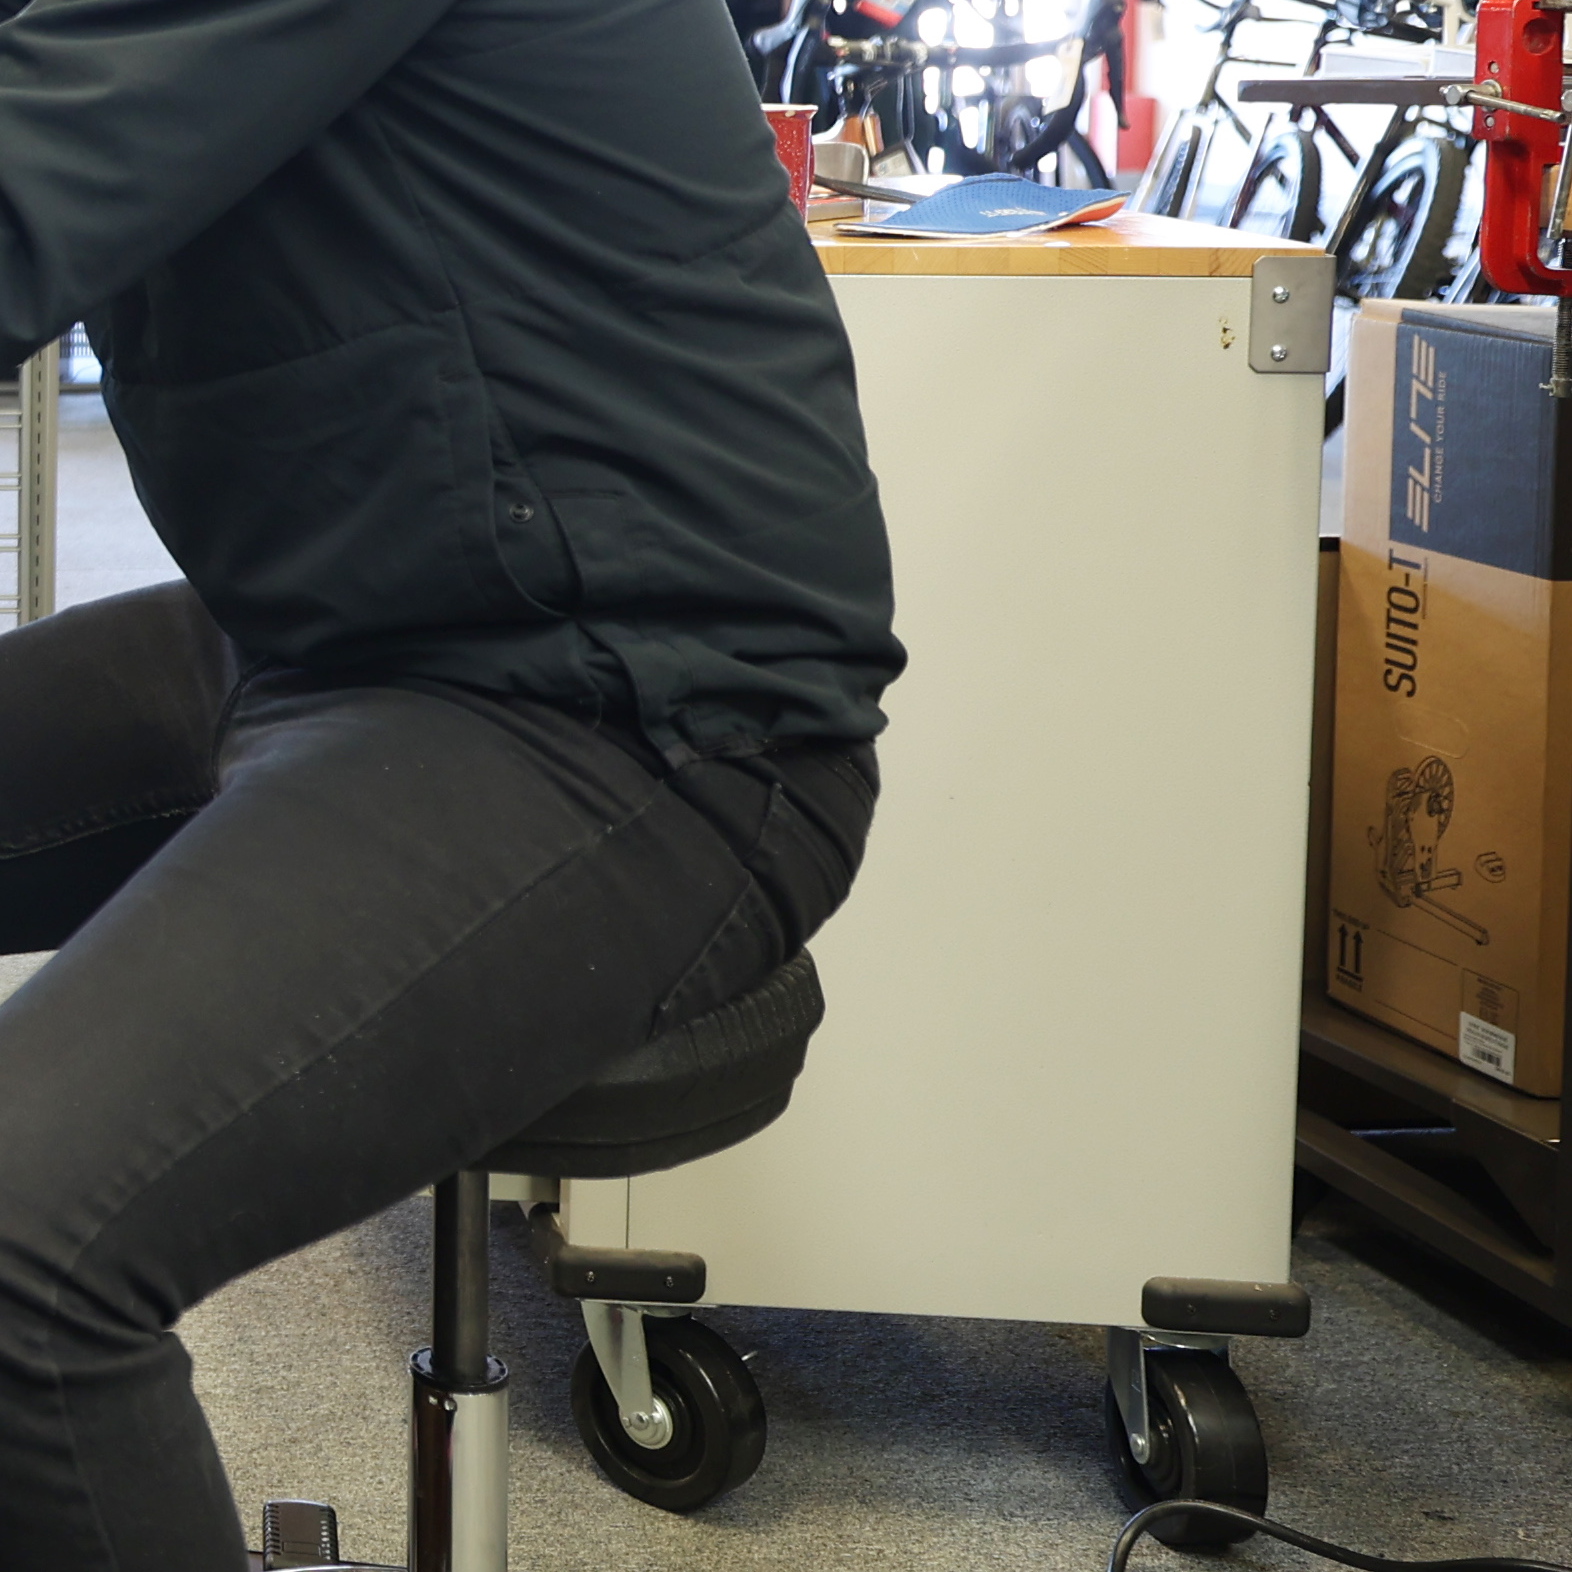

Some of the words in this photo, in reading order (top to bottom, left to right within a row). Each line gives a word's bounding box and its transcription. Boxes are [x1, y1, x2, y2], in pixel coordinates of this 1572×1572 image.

[1437, 371, 1448, 402] RIDE
[1406, 334, 1436, 533] ELITE
[1436, 406, 1446, 443] YOUR
[1433, 446, 1444, 503] CHANGE
[1383, 548, 1422, 698] SUITO-T
